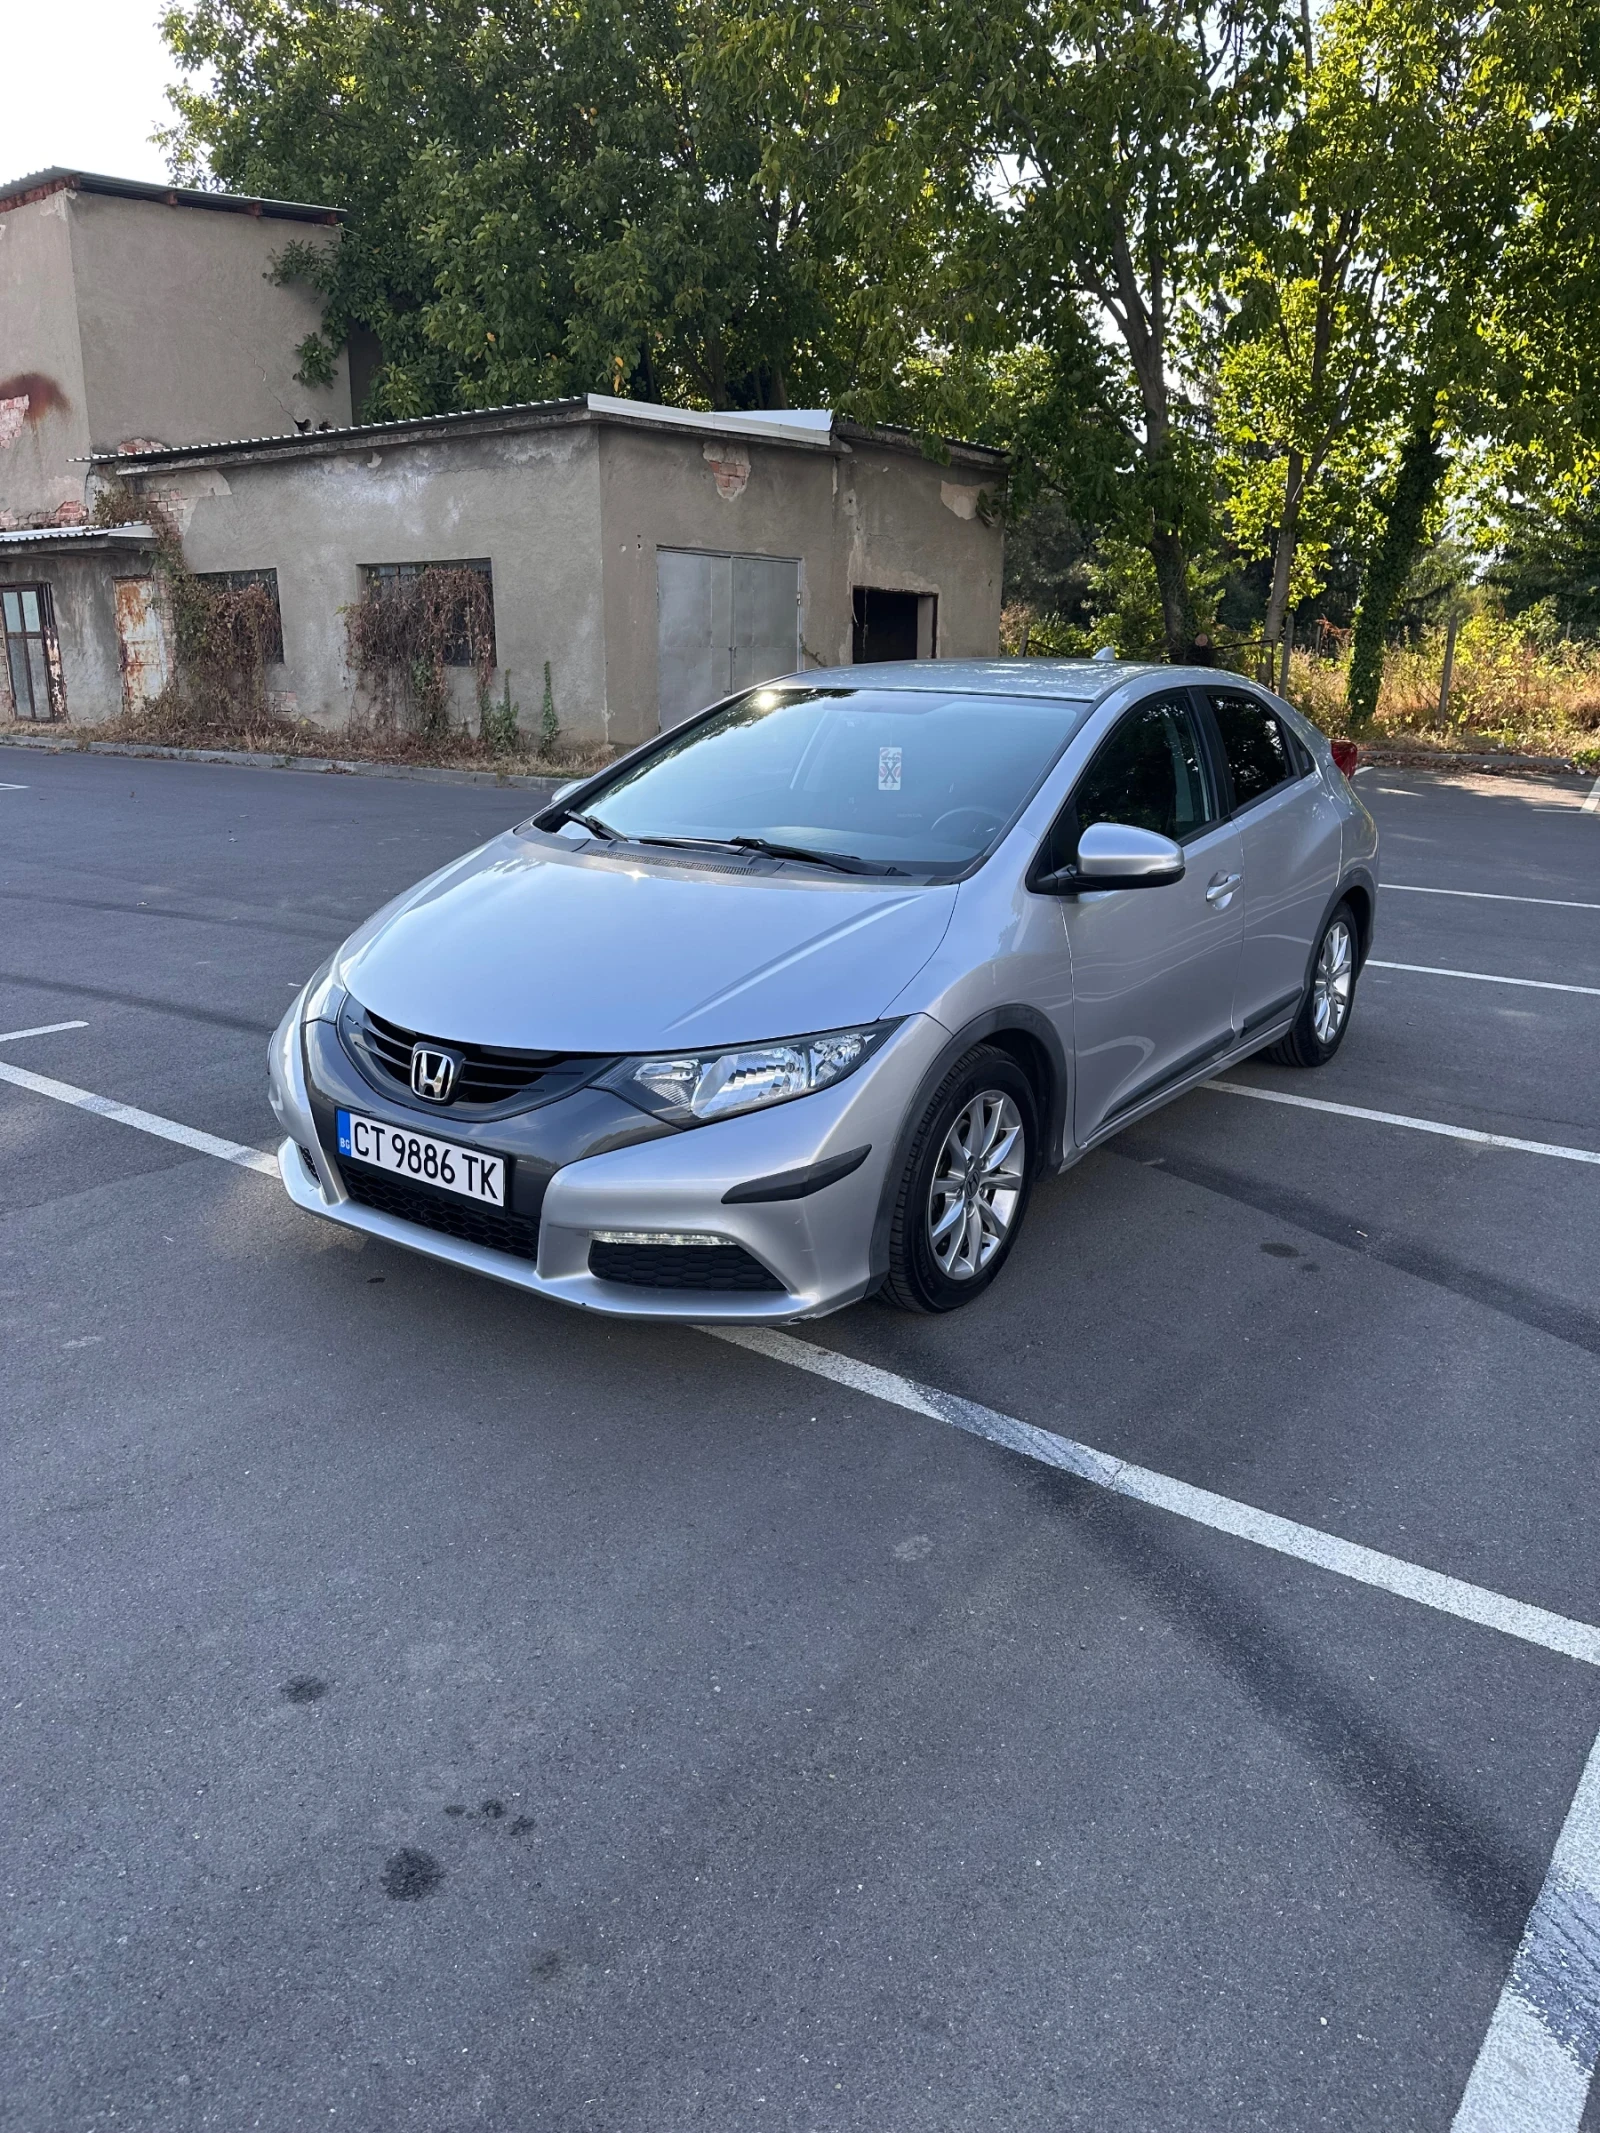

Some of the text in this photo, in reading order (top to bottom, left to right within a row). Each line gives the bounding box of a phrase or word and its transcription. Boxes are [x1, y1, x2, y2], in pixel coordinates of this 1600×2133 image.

[880, 761, 899, 784] X
[340, 1137, 351, 1150] BG
[354, 1121, 498, 1200] CT 9886 TK
